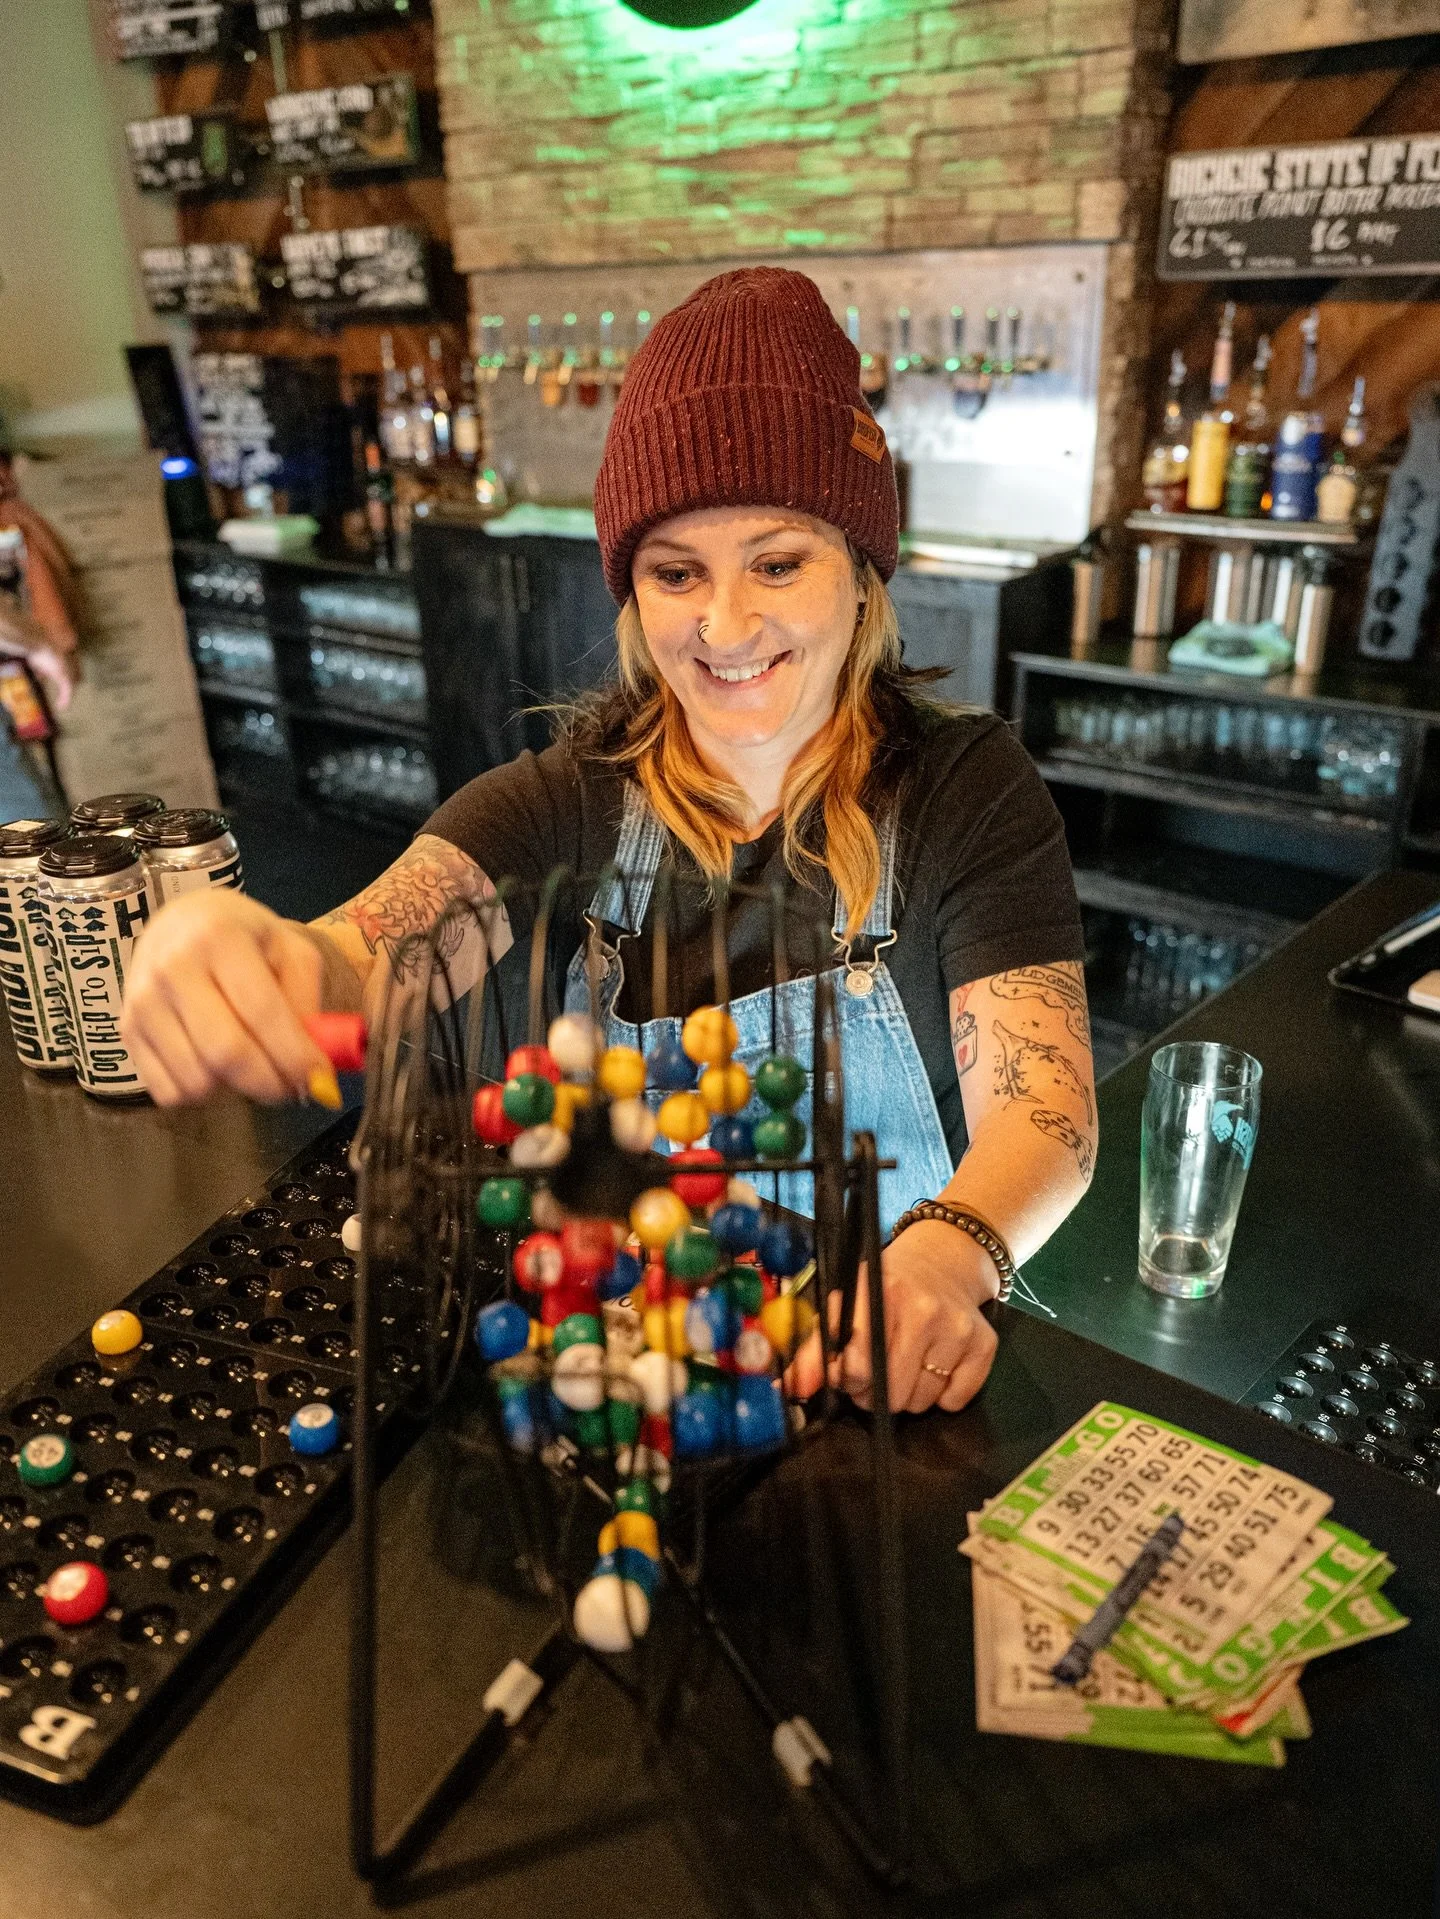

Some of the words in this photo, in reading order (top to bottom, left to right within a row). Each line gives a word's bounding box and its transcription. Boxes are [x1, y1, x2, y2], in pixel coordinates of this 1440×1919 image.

[64, 934, 111, 970] Sip
[80, 977, 110, 1007] To
[81, 1011, 121, 1043] Hip
[87, 1048, 138, 1086] Too
[1036, 1519, 1061, 1537] 9
[1056, 1489, 1091, 1516] 30
[1081, 1466, 1115, 1491] 33
[1104, 1445, 1137, 1469] 55
[1125, 1423, 1159, 1446] 70
[1413, 1454, 1426, 1465] 57
[1064, 1530, 1102, 1560] 13
[1090, 1506, 1124, 1534] 27
[1114, 1481, 1146, 1508] 37
[1137, 1458, 1171, 1483] 60
[1160, 1437, 1192, 1460] 65
[1104, 1553, 1128, 1571] 7
[1171, 1473, 1204, 1500] 57
[1192, 1453, 1228, 1475] 71
[1185, 1515, 1219, 1541] 45
[1206, 1489, 1242, 1517] 50
[1228, 1467, 1261, 1493] 74
[1178, 1593, 1208, 1614] 5
[1197, 1560, 1235, 1591] 29
[1224, 1532, 1257, 1559] 40
[1243, 1508, 1279, 1536] 51
[1263, 1483, 1299, 1510] 75
[19, 1704, 97, 1760] B
